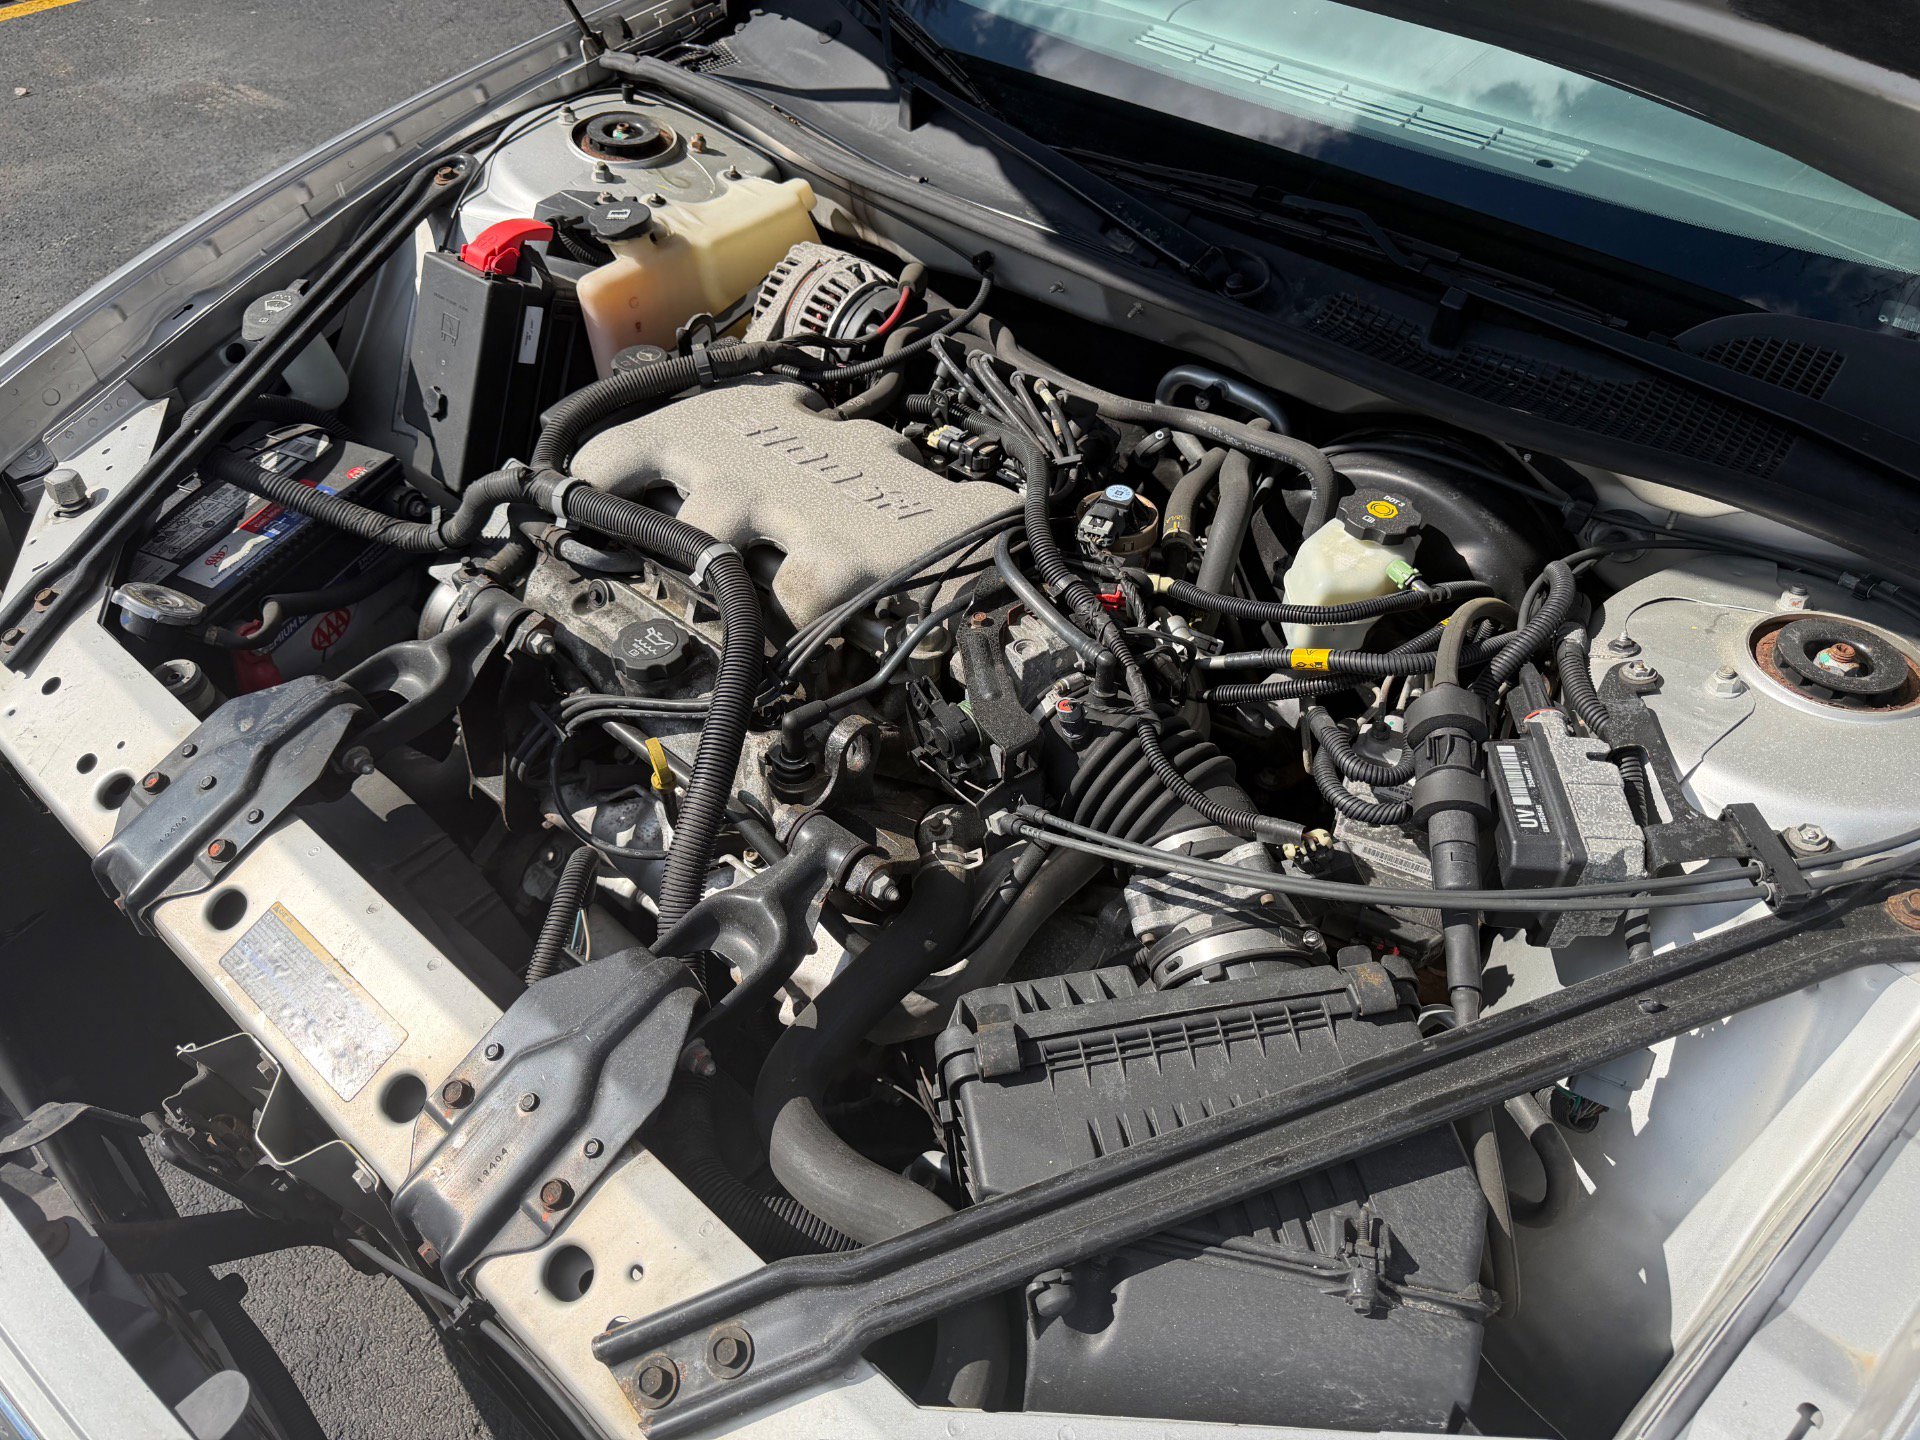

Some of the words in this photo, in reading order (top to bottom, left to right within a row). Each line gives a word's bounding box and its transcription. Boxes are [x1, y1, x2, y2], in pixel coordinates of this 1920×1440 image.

[1383, 495, 1400, 504] DOT
[312, 607, 351, 651] AAA
[1515, 808, 1539, 828] UV
[476, 1147, 509, 1184] 19404
